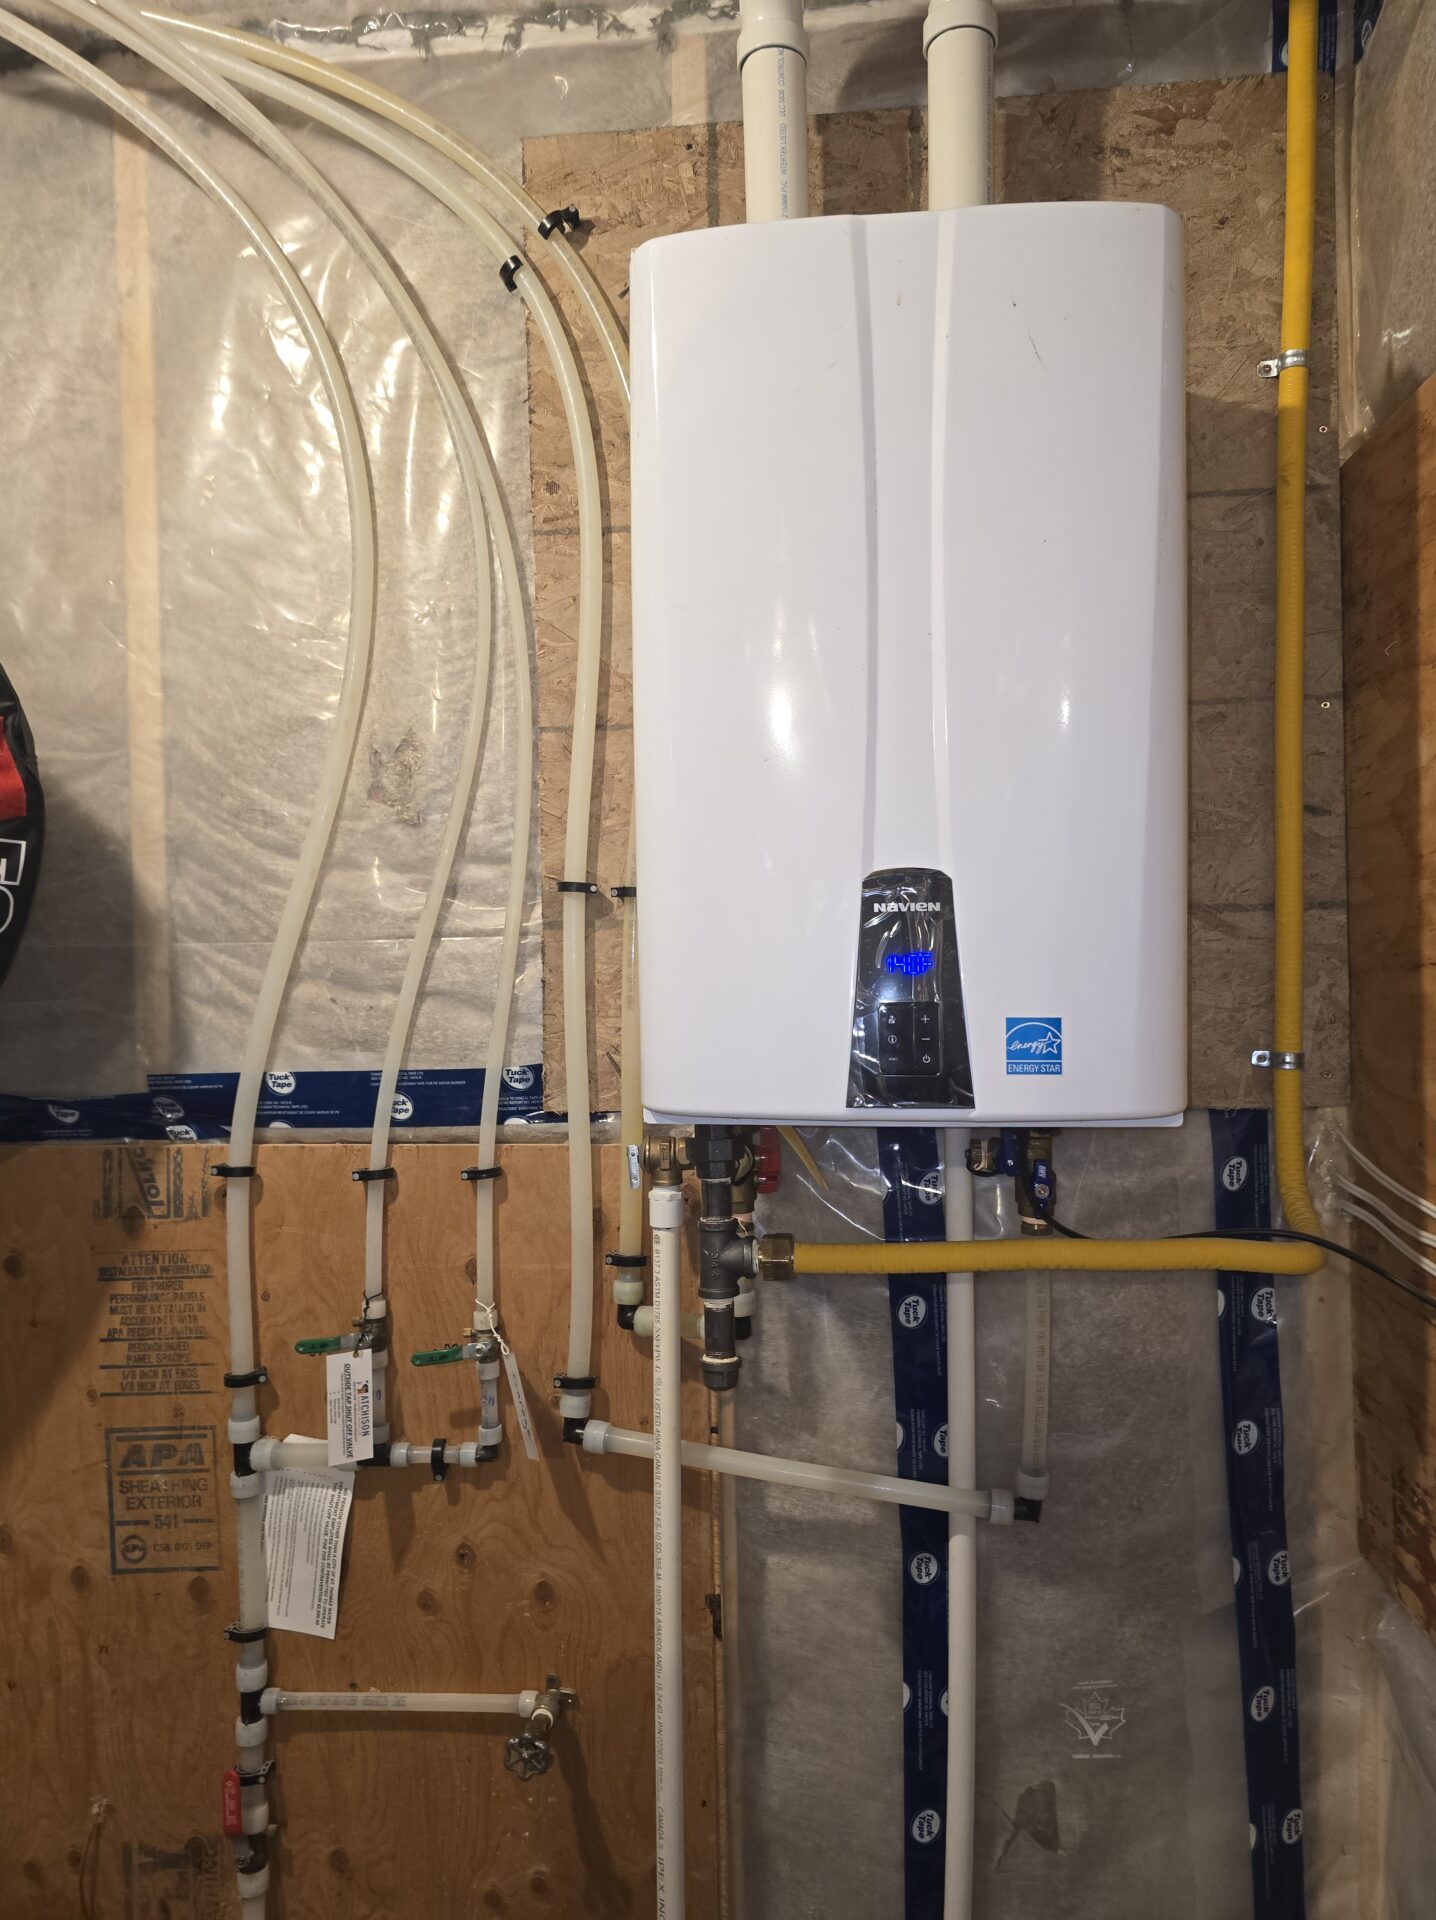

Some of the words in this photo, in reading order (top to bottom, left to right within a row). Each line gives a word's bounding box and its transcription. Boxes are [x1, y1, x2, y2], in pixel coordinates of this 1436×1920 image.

[269, 1073, 292, 1081] Tuck
[1008, 1064, 1040, 1073] ENERGY
[1041, 1064, 1061, 1073] STAR
[271, 1081, 293, 1089] Tape
[1227, 1163, 1236, 1187] Tape
[903, 1302, 912, 1325] Tape
[912, 1299, 921, 1323] Tuck
[1255, 1292, 1265, 1317] Tape
[1265, 1290, 1274, 1315] Tuck
[361, 1395, 370, 1437] ATCHISON
[1243, 1423, 1252, 1449] Tuck
[118, 1443, 206, 1468] APA
[125, 1495, 203, 1510] EXTERIOR
[154, 1514, 179, 1530] 541
[915, 1556, 924, 1580] Tape
[924, 1555, 933, 1579] Tuck
[1272, 1556, 1281, 1582] Tape
[1281, 1553, 1290, 1578] Tuck
[1255, 1692, 1263, 1718] Tape
[1263, 1689, 1271, 1713] Tuck
[917, 1815, 926, 1839] Tape
[926, 1813, 934, 1837] Tuck
[1285, 1816, 1294, 1841] Tape
[1293, 1811, 1301, 1836] Tuck
